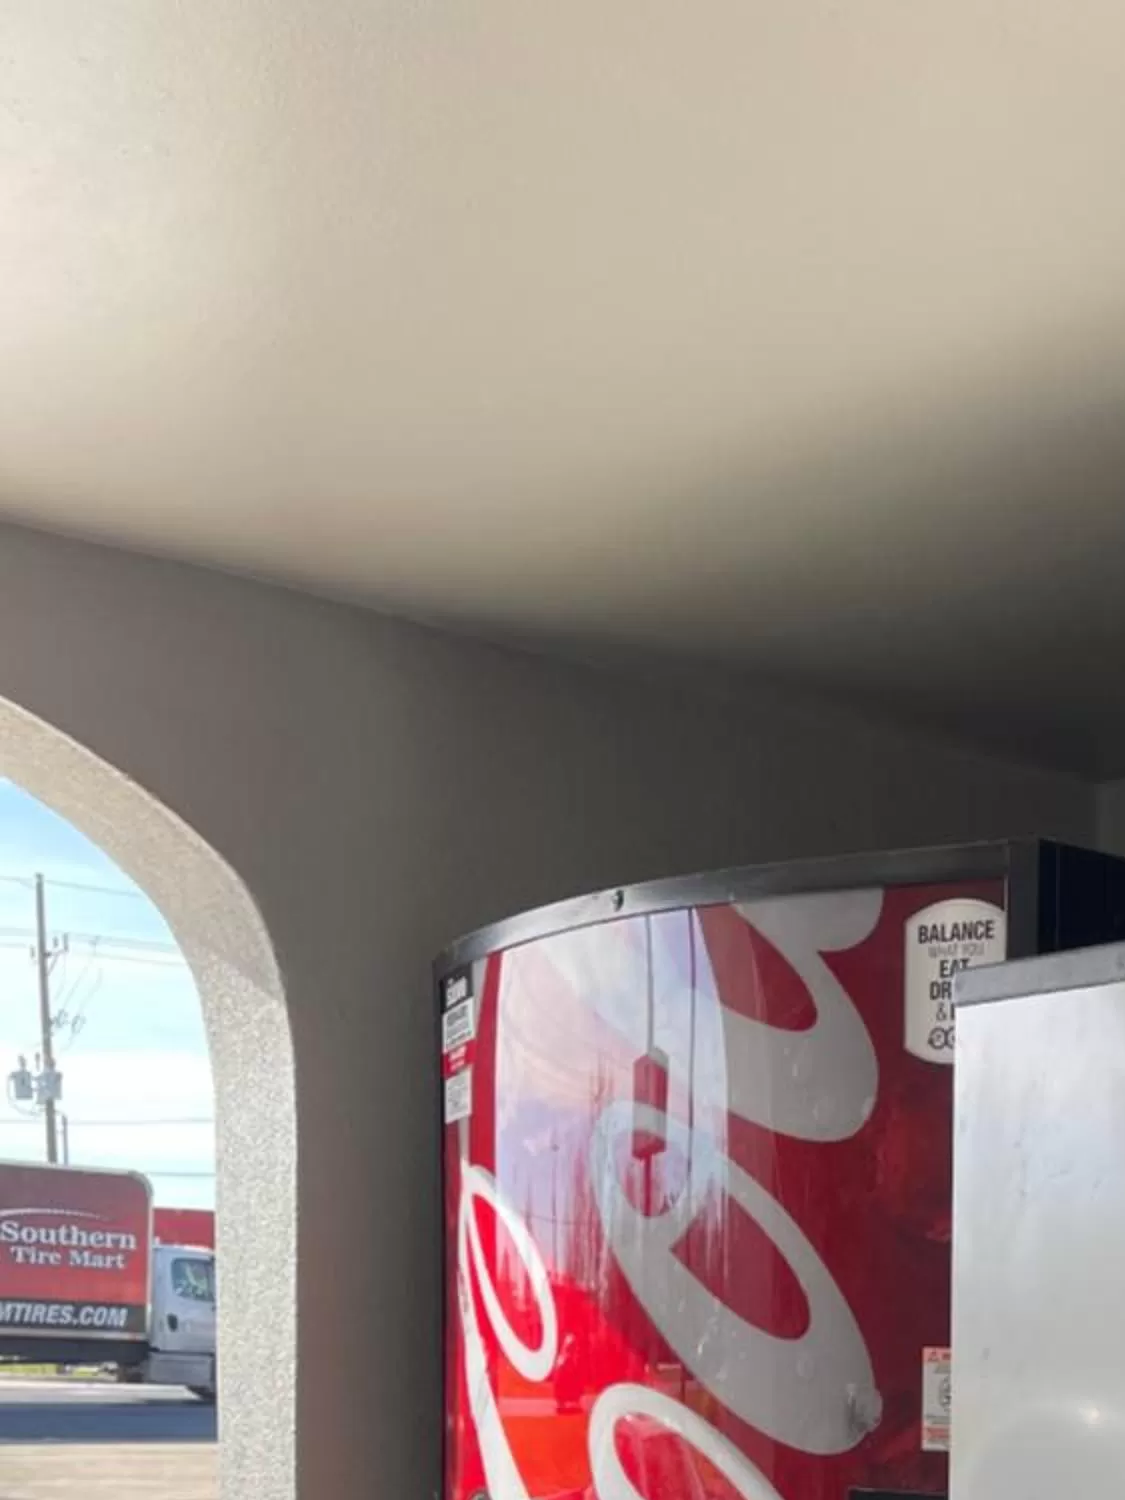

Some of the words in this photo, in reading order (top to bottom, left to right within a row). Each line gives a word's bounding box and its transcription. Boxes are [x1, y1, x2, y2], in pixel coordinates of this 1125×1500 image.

[918, 921, 995, 944] BALANCE
[0, 1221, 136, 1250] Southern
[10, 1246, 61, 1265] Tire
[69, 1250, 126, 1269] Mart
